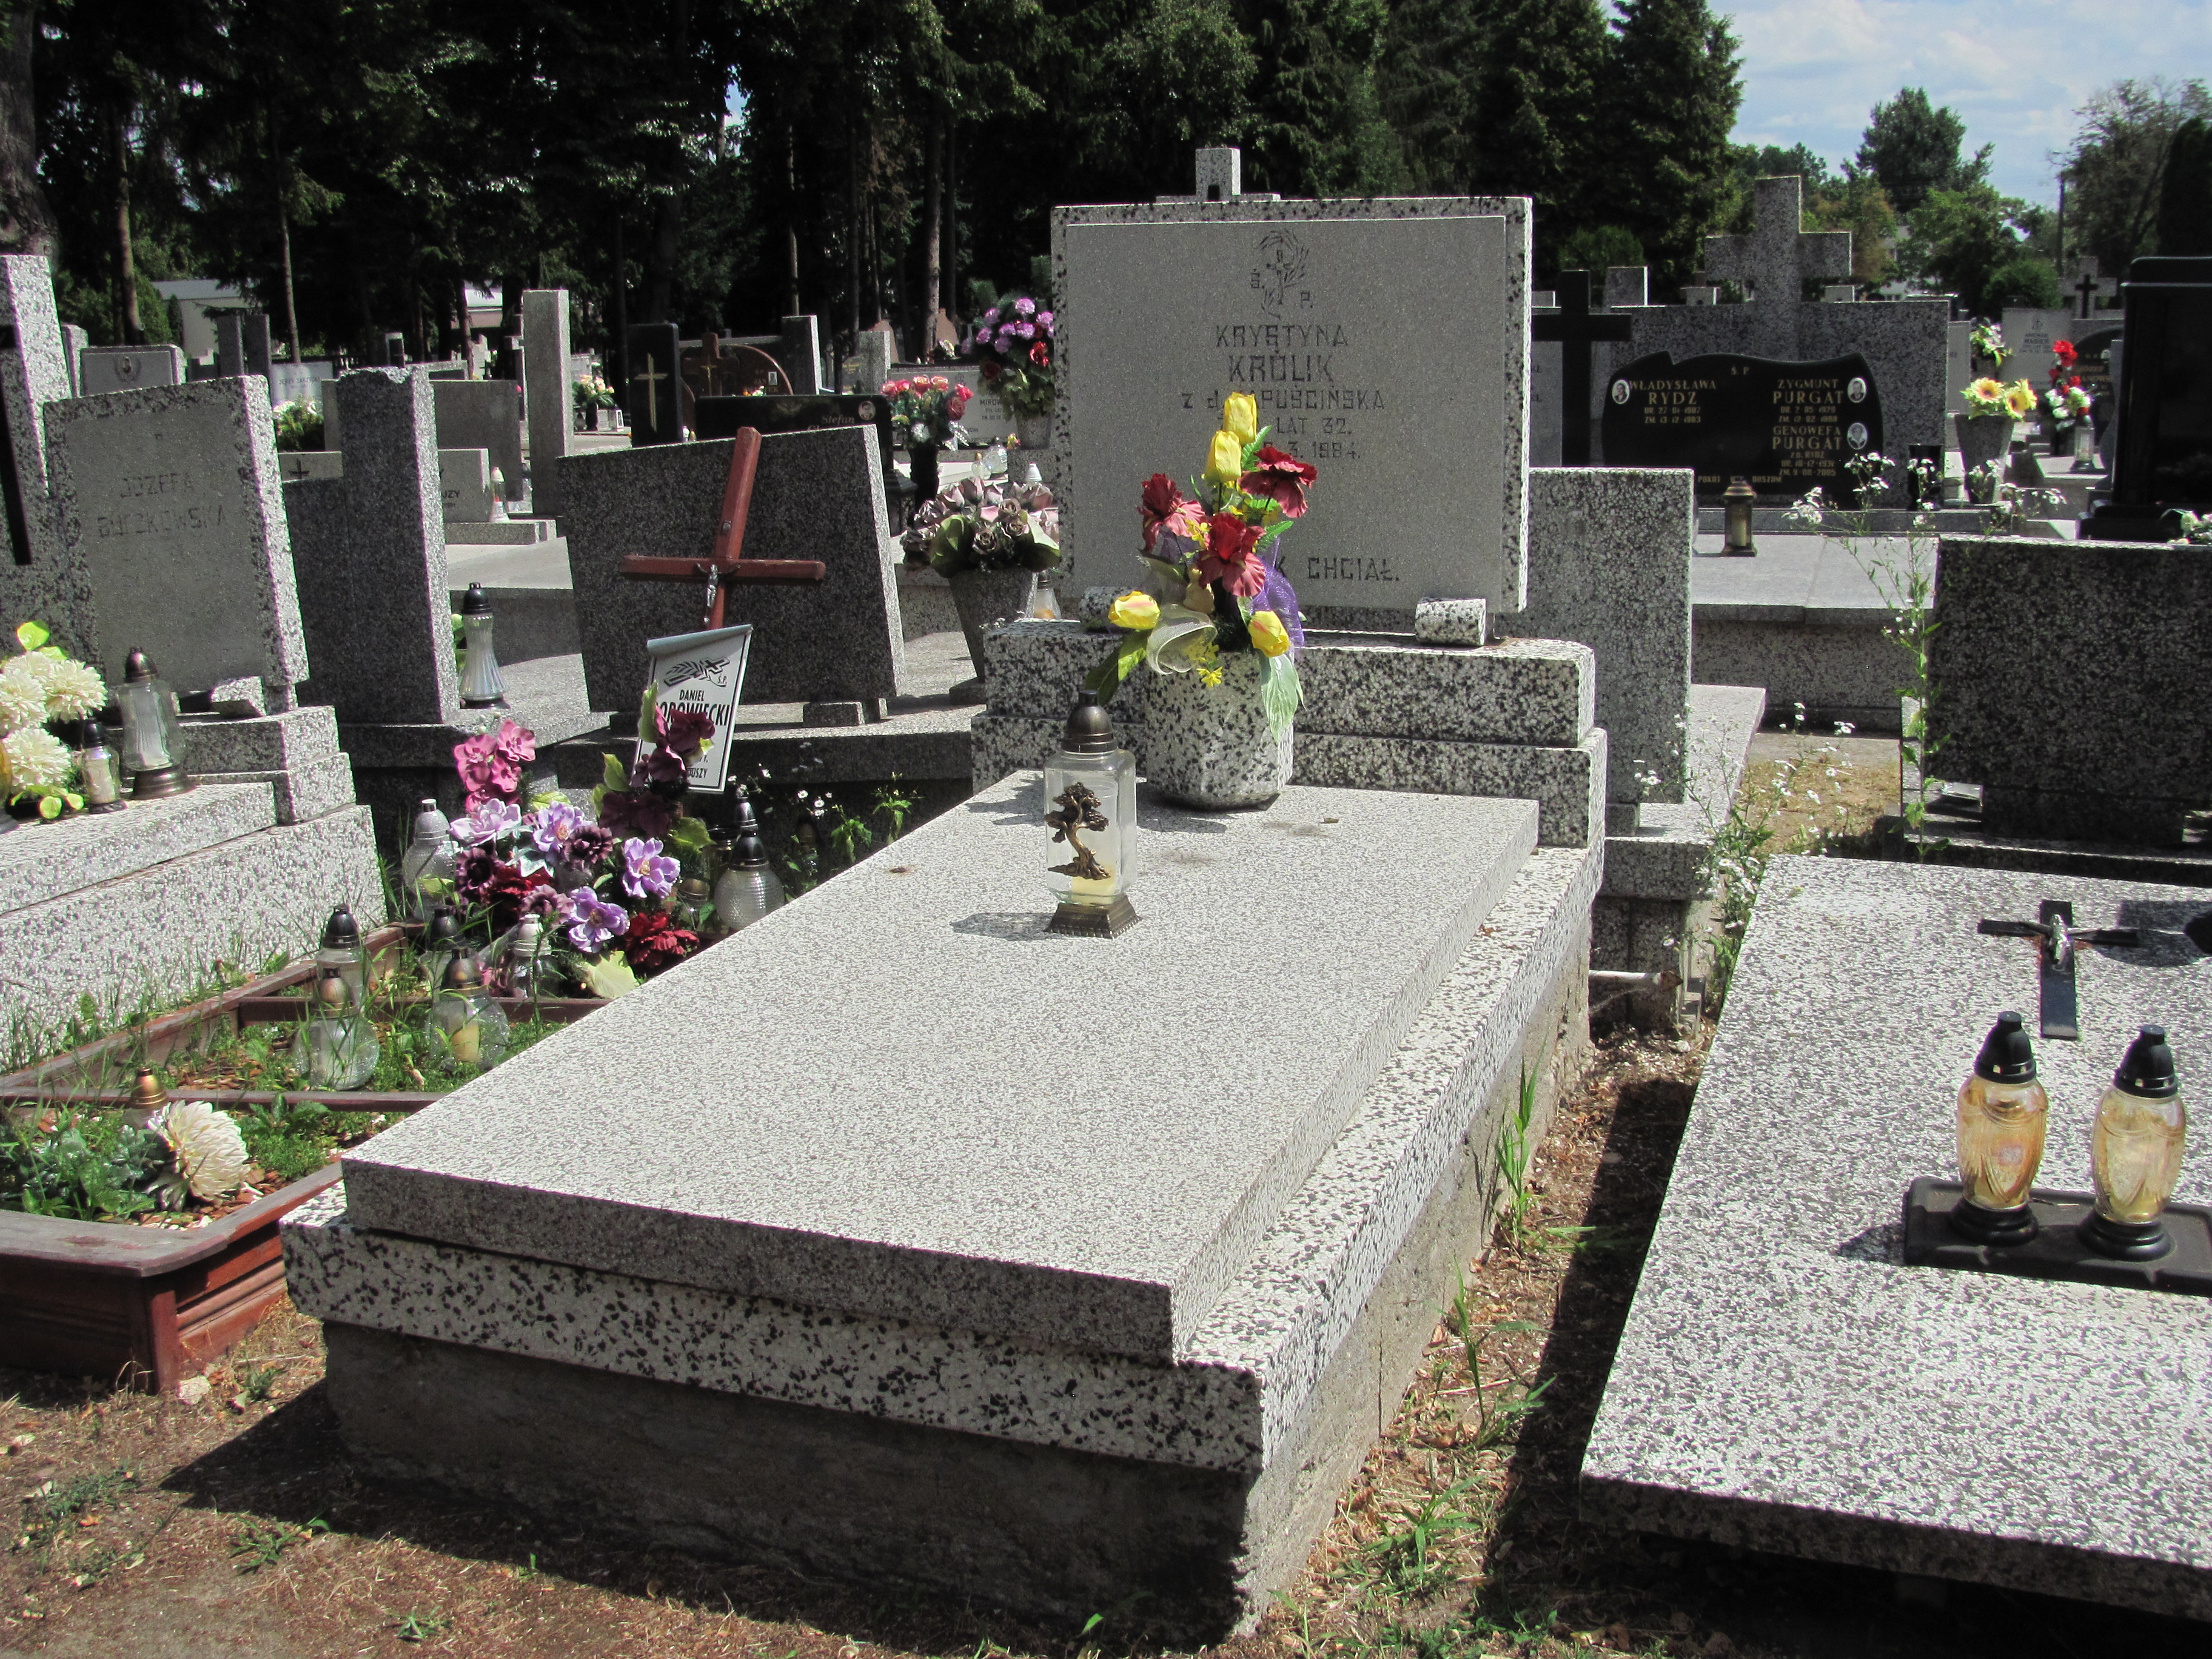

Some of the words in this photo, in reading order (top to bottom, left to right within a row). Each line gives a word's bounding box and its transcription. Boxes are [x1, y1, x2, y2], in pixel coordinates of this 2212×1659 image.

[1216, 324, 1349, 347] KRYSTYNA
[1229, 350, 1335, 382] KRÓLIK
[1629, 380, 1717, 390] WŁADYSŁAWA
[1777, 379, 1838, 389] ZYGMUNT
[1249, 386, 1386, 410] APUŚCIŃSKA
[1648, 392, 1697, 404] RYDZ
[1772, 390, 1843, 404] PURGAT
[822, 415, 855, 426] Stefan
[1277, 417, 1309, 434] LAT
[1324, 417, 1353, 435] 32.
[1772, 426, 1841, 435] GENOWEFA
[1772, 437, 1842, 449] PURGAT
[1308, 557, 1399, 581] CHCIAŁ.
[679, 689, 705, 701] DANIEL
[657, 701, 731, 726] OROWIECKI
